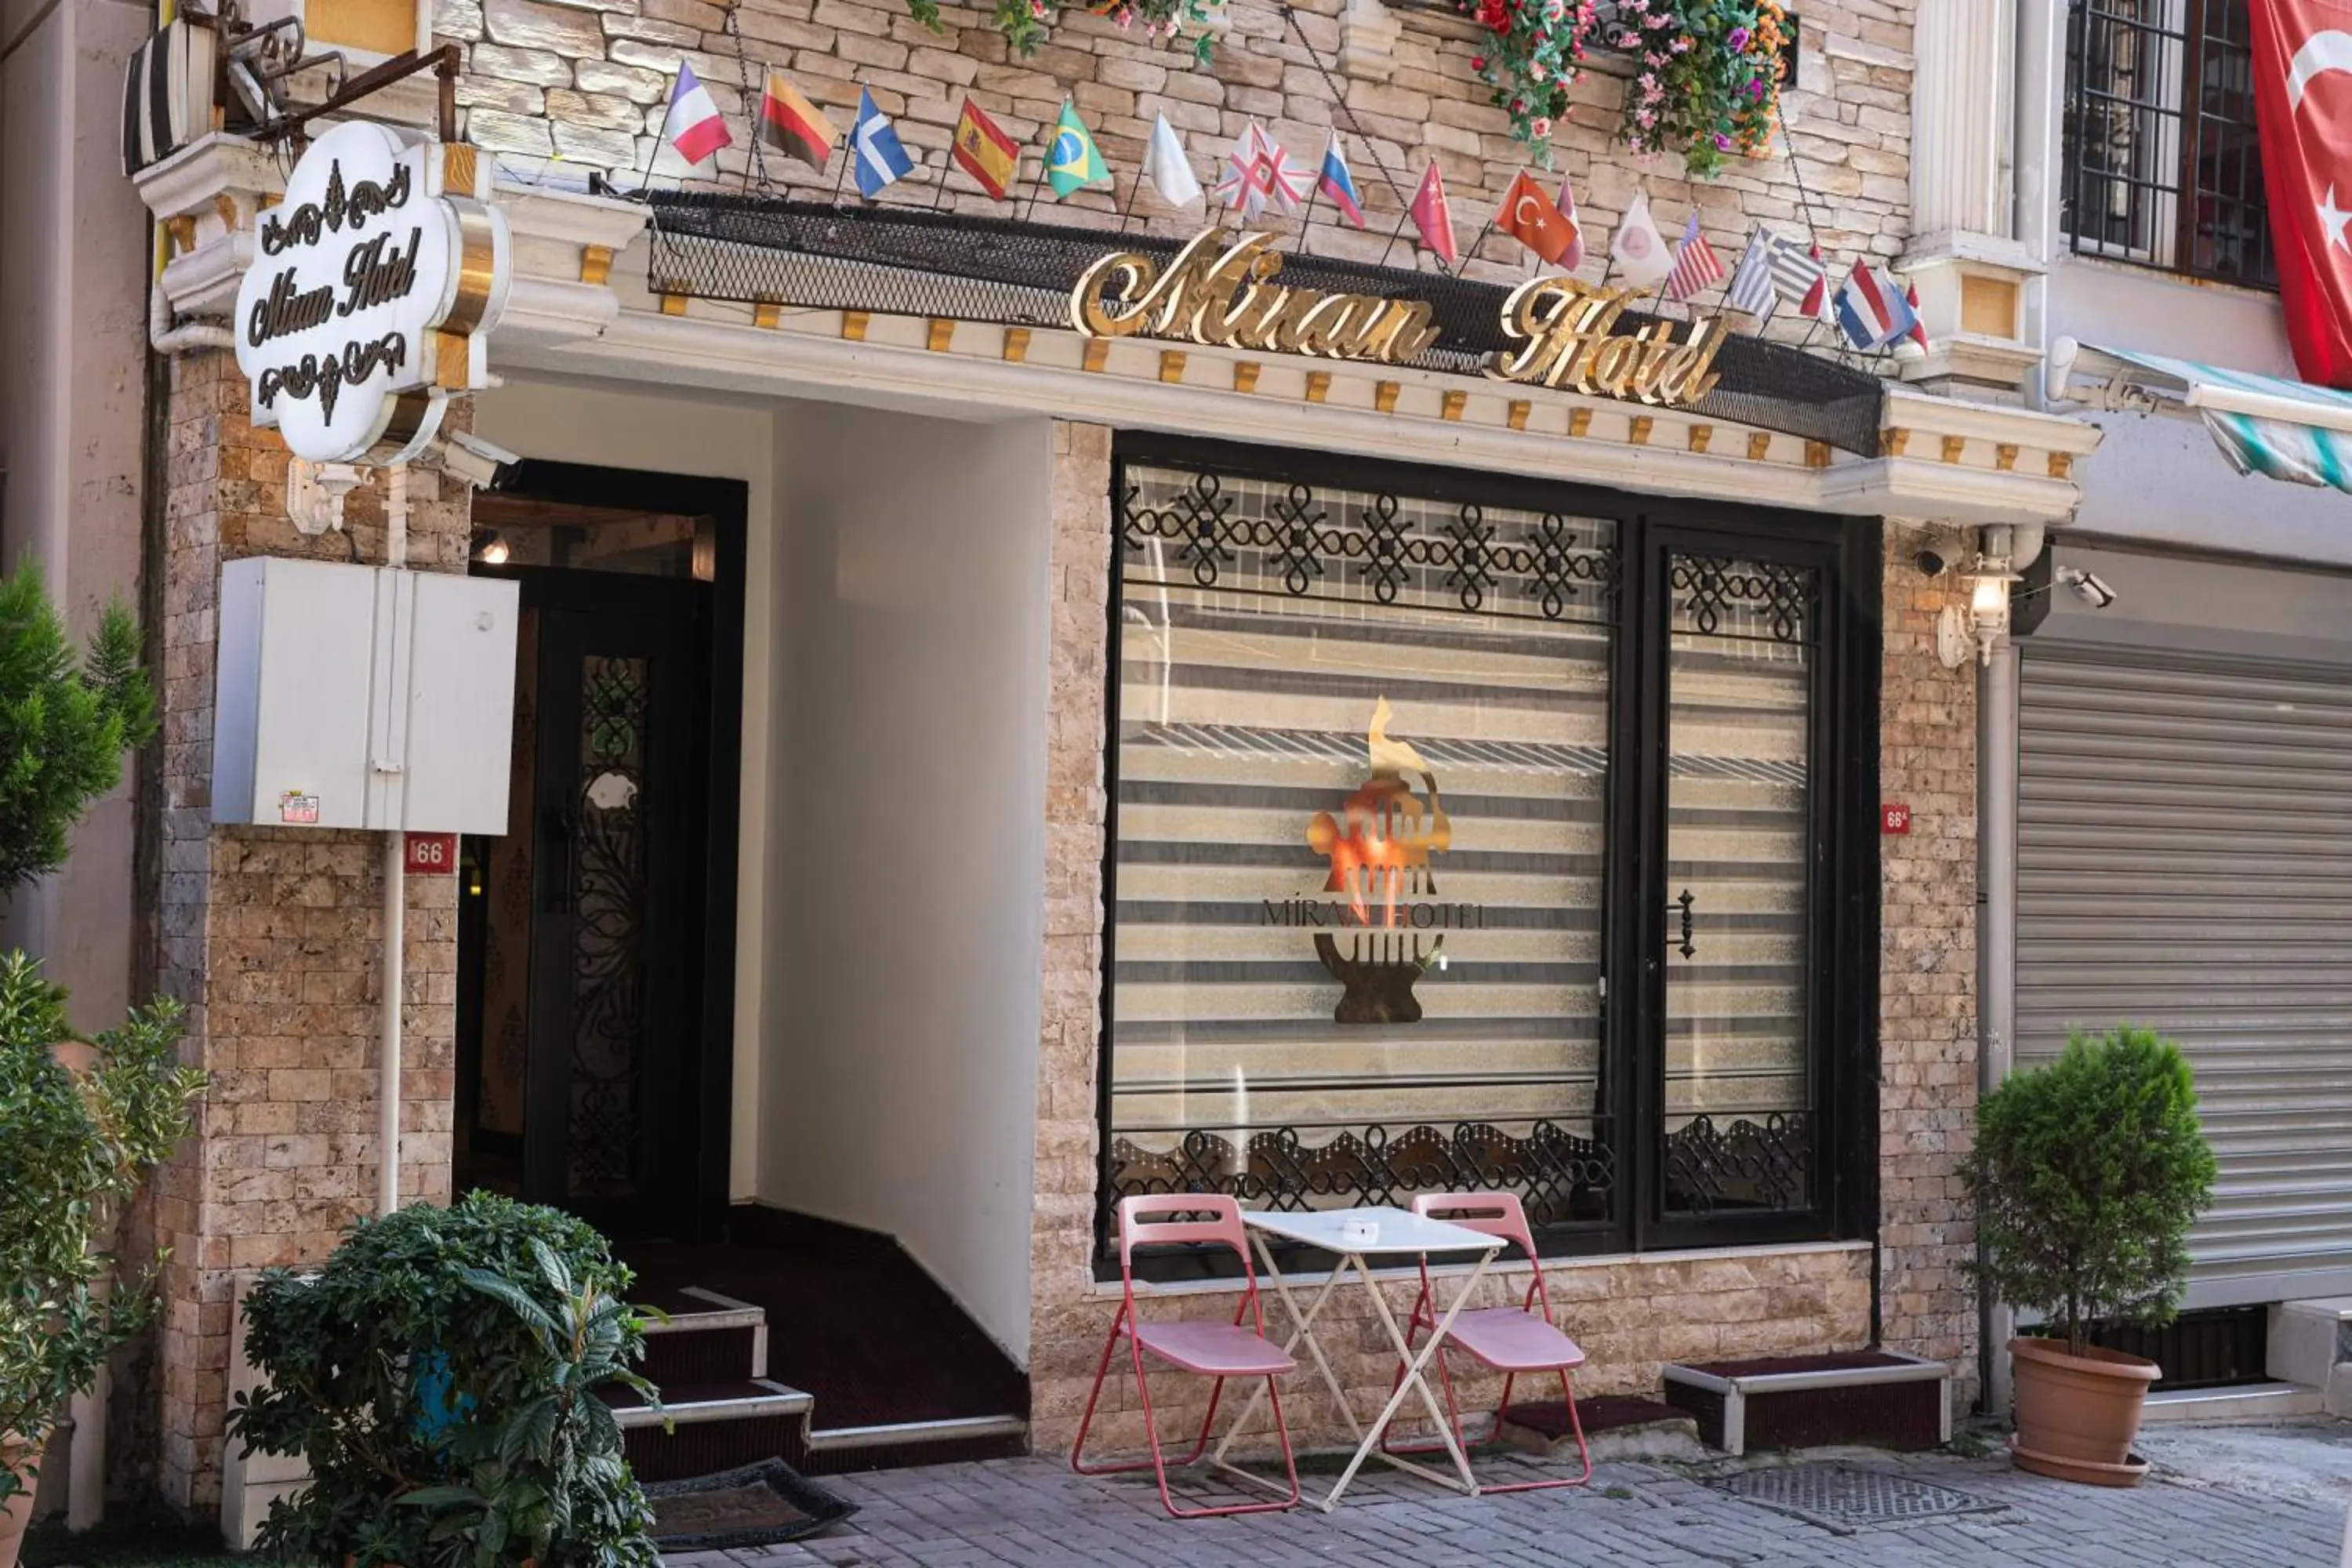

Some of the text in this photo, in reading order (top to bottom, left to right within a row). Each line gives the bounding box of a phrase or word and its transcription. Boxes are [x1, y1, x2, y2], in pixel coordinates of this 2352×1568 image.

[337, 227, 422, 318] Hotel
[1070, 226, 1730, 406] Miran Hotel
[418, 842, 442, 863] 66
